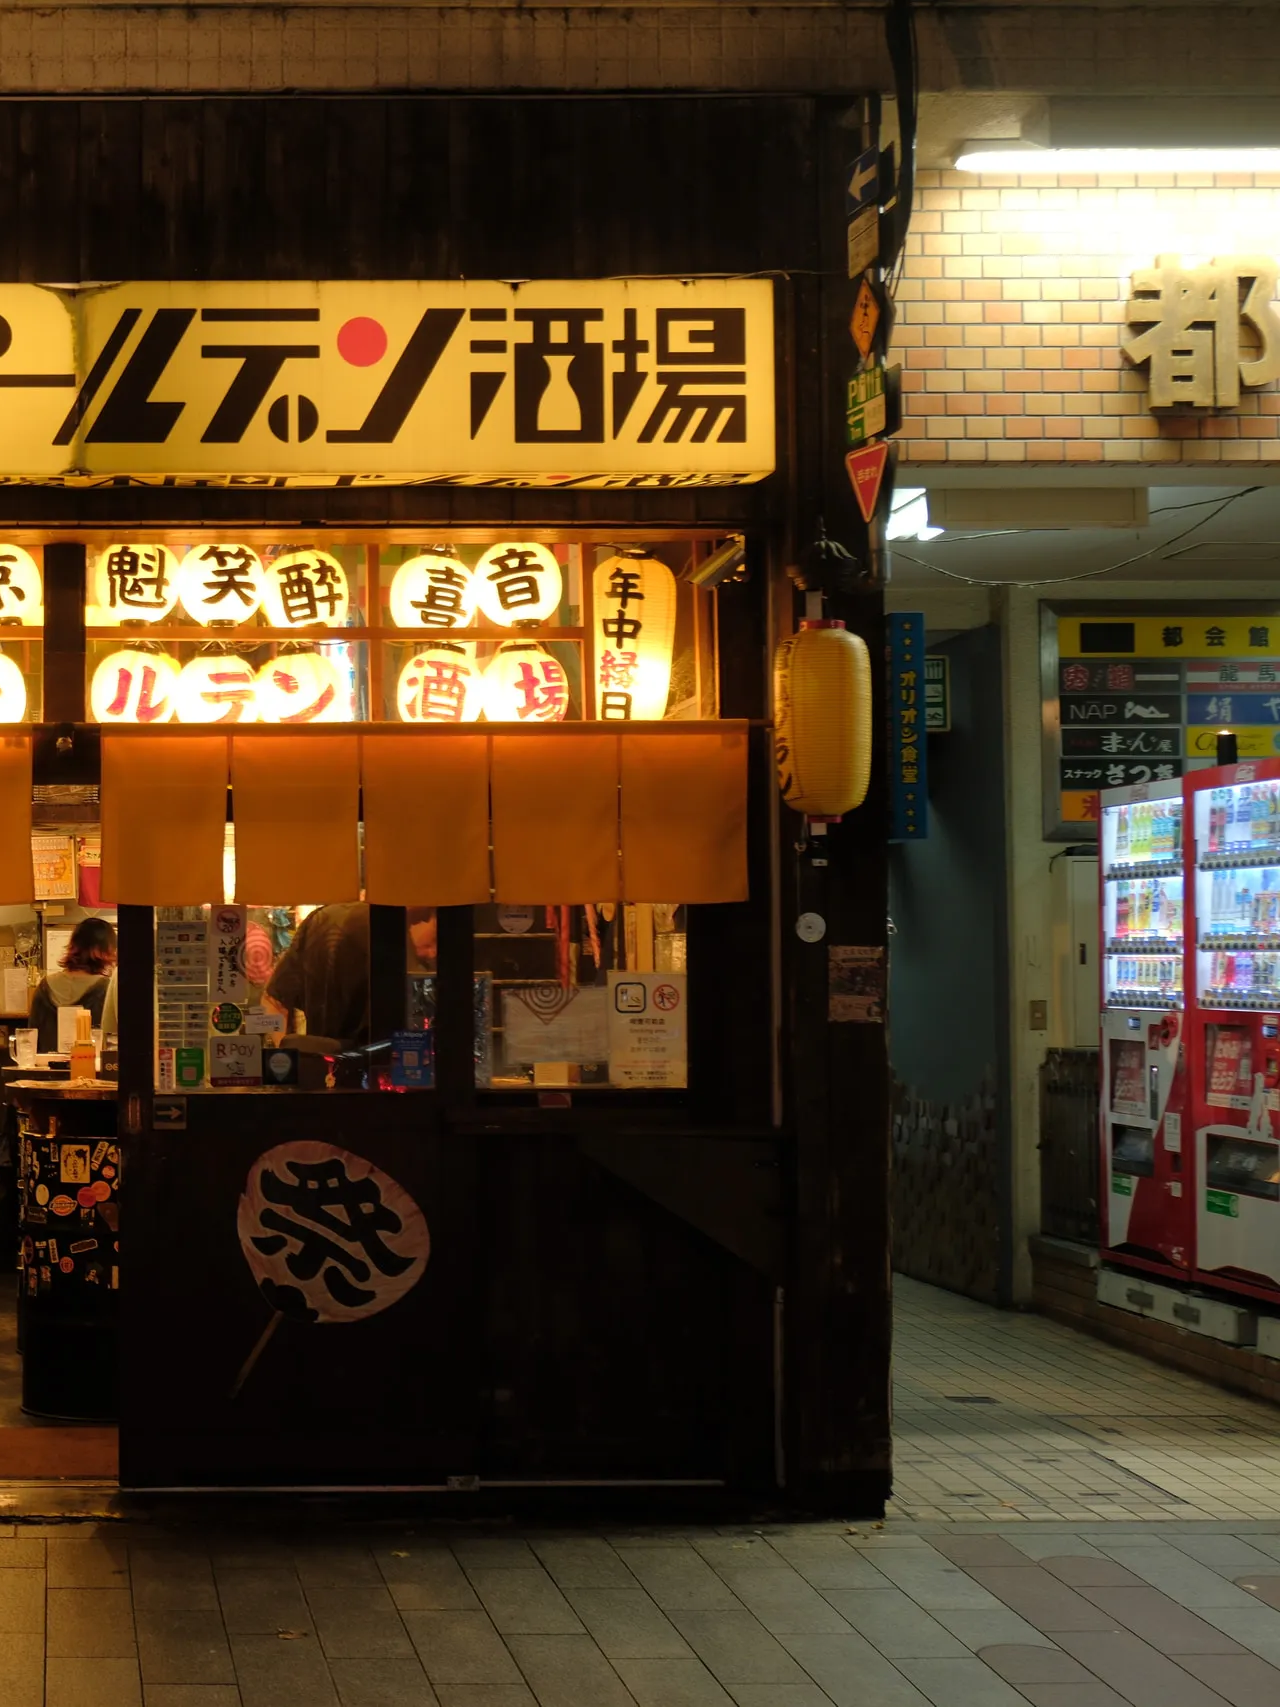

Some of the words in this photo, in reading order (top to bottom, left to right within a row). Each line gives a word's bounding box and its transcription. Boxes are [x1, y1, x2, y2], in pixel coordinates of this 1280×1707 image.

[1122, 252, 1280, 411] 都
[598, 567, 645, 721] 年中縁日
[900, 670, 918, 784] オリオン食堂
